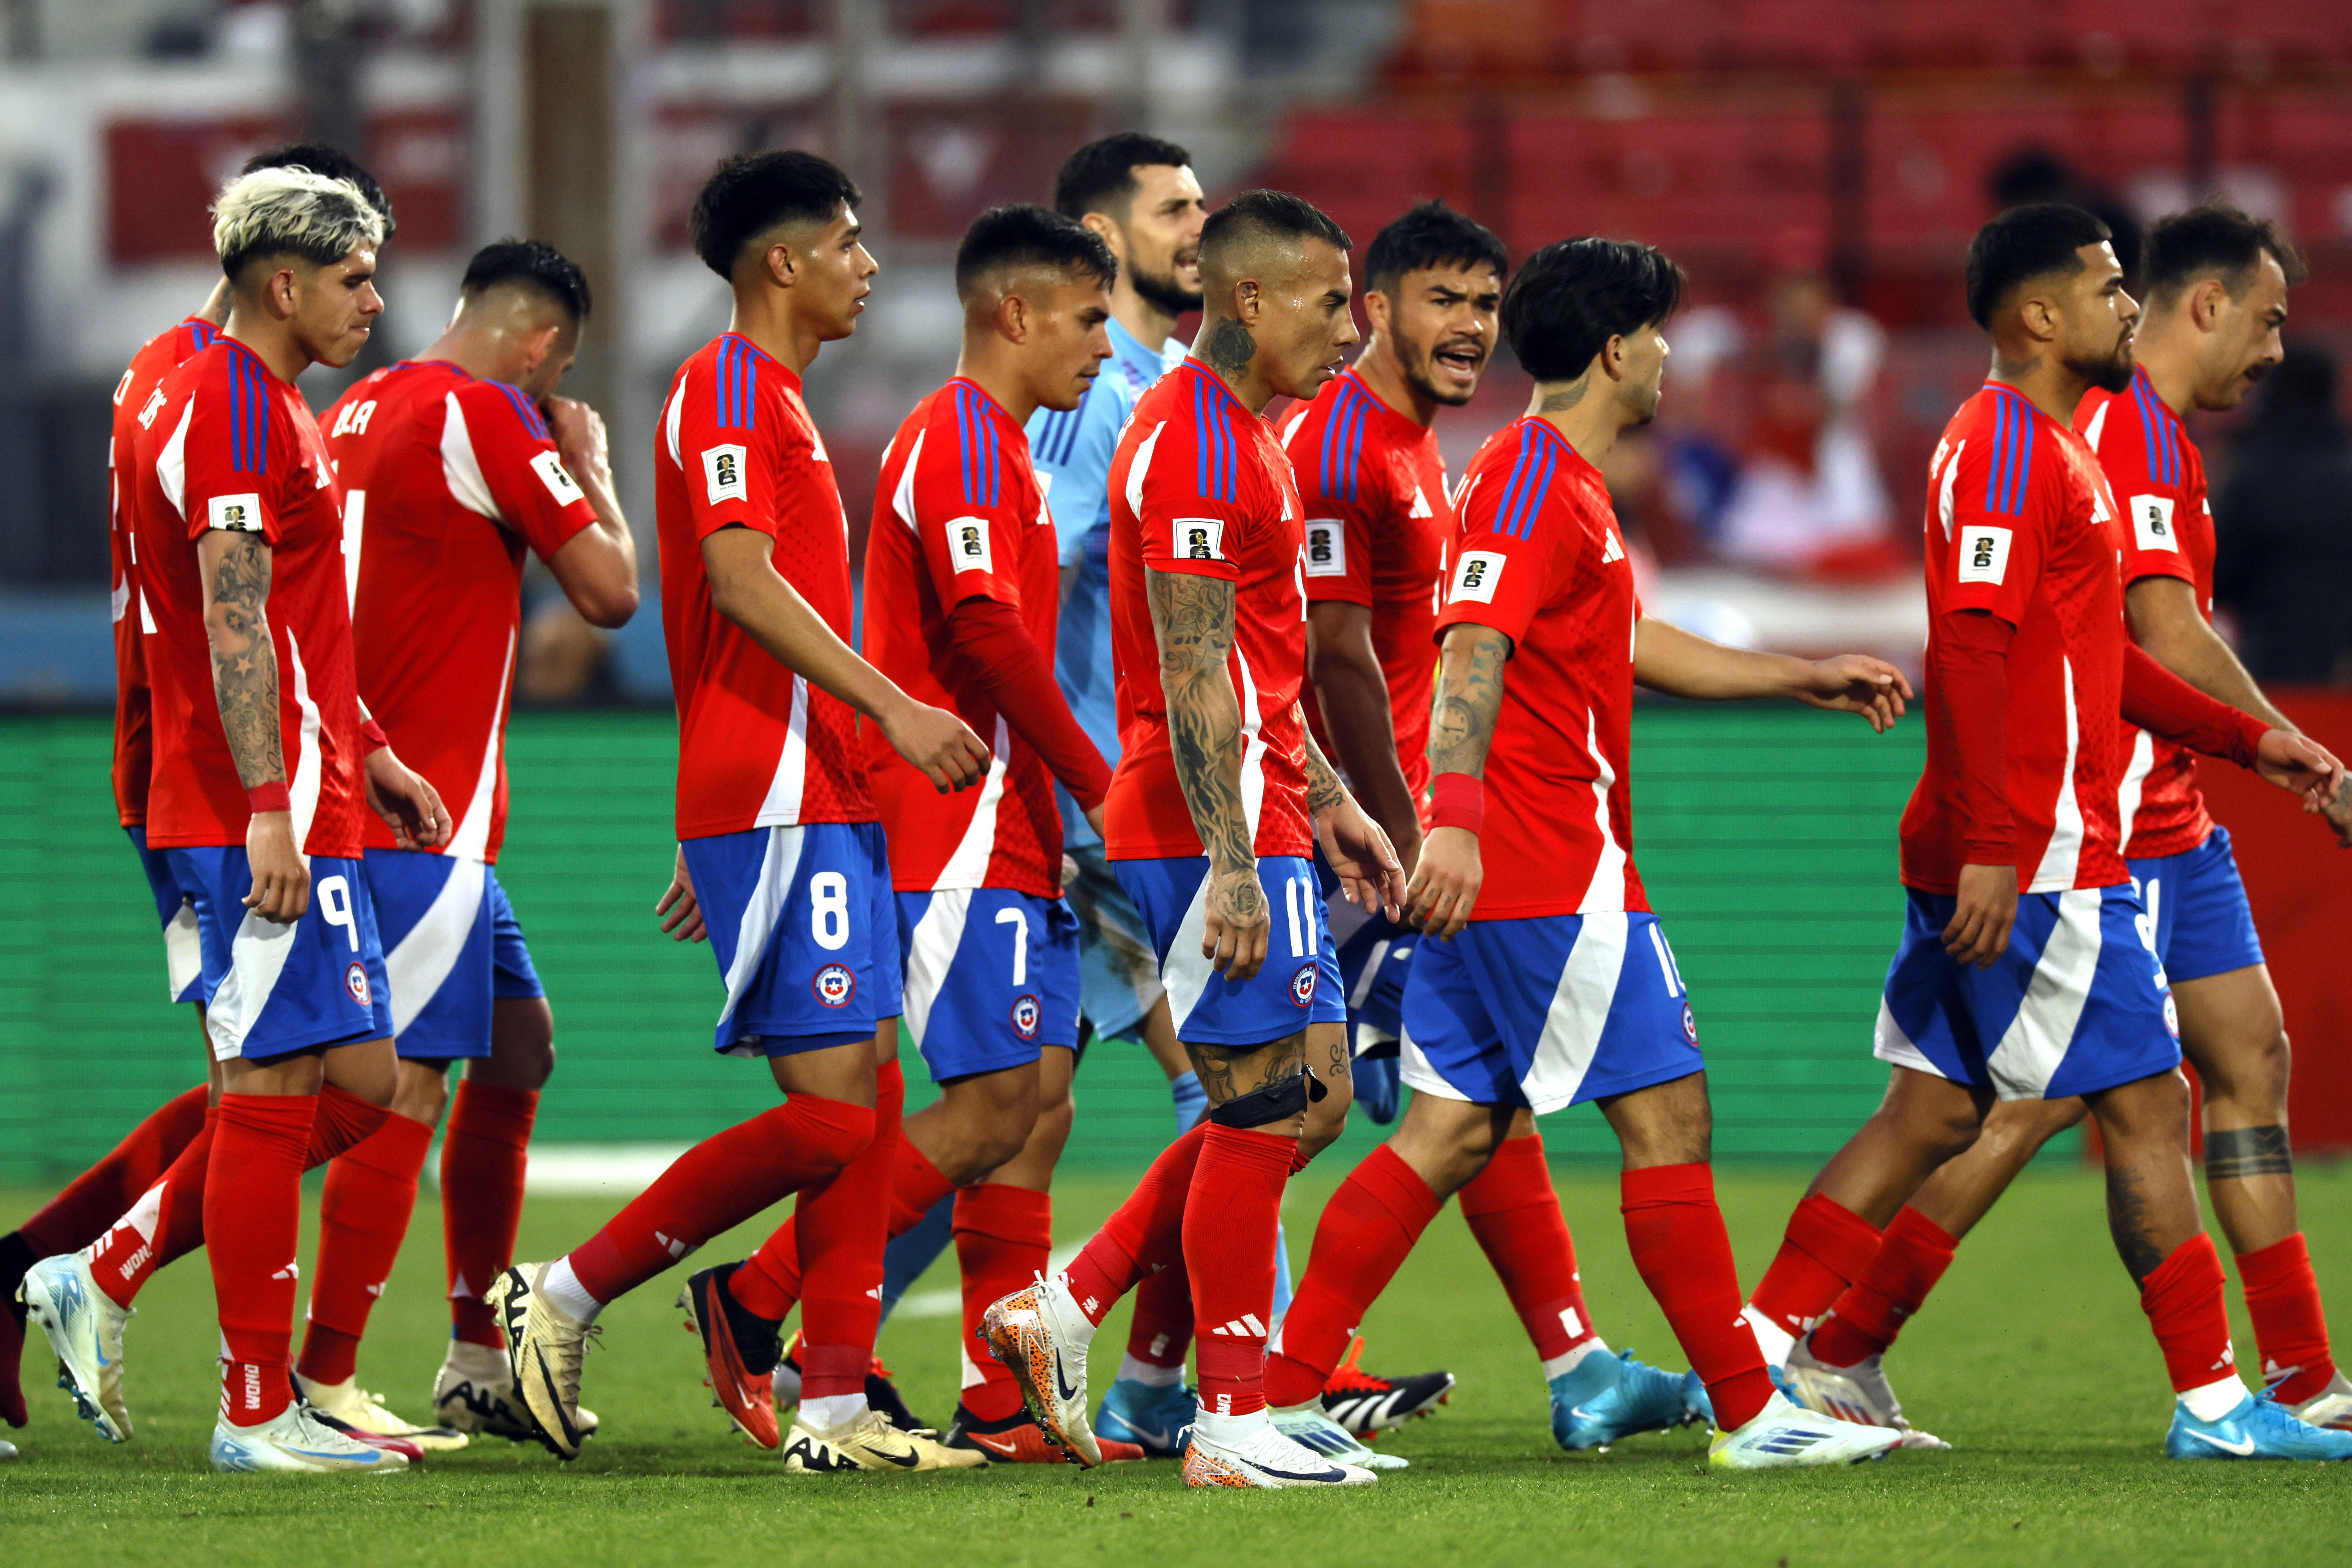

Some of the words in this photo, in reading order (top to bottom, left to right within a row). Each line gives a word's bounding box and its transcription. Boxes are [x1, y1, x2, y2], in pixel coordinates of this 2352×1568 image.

[317, 875, 359, 953] 9
[810, 871, 849, 951] 8
[995, 907, 1029, 986] 7
[1286, 877, 1317, 957] 11
[1275, 1421, 1325, 1433] F50
